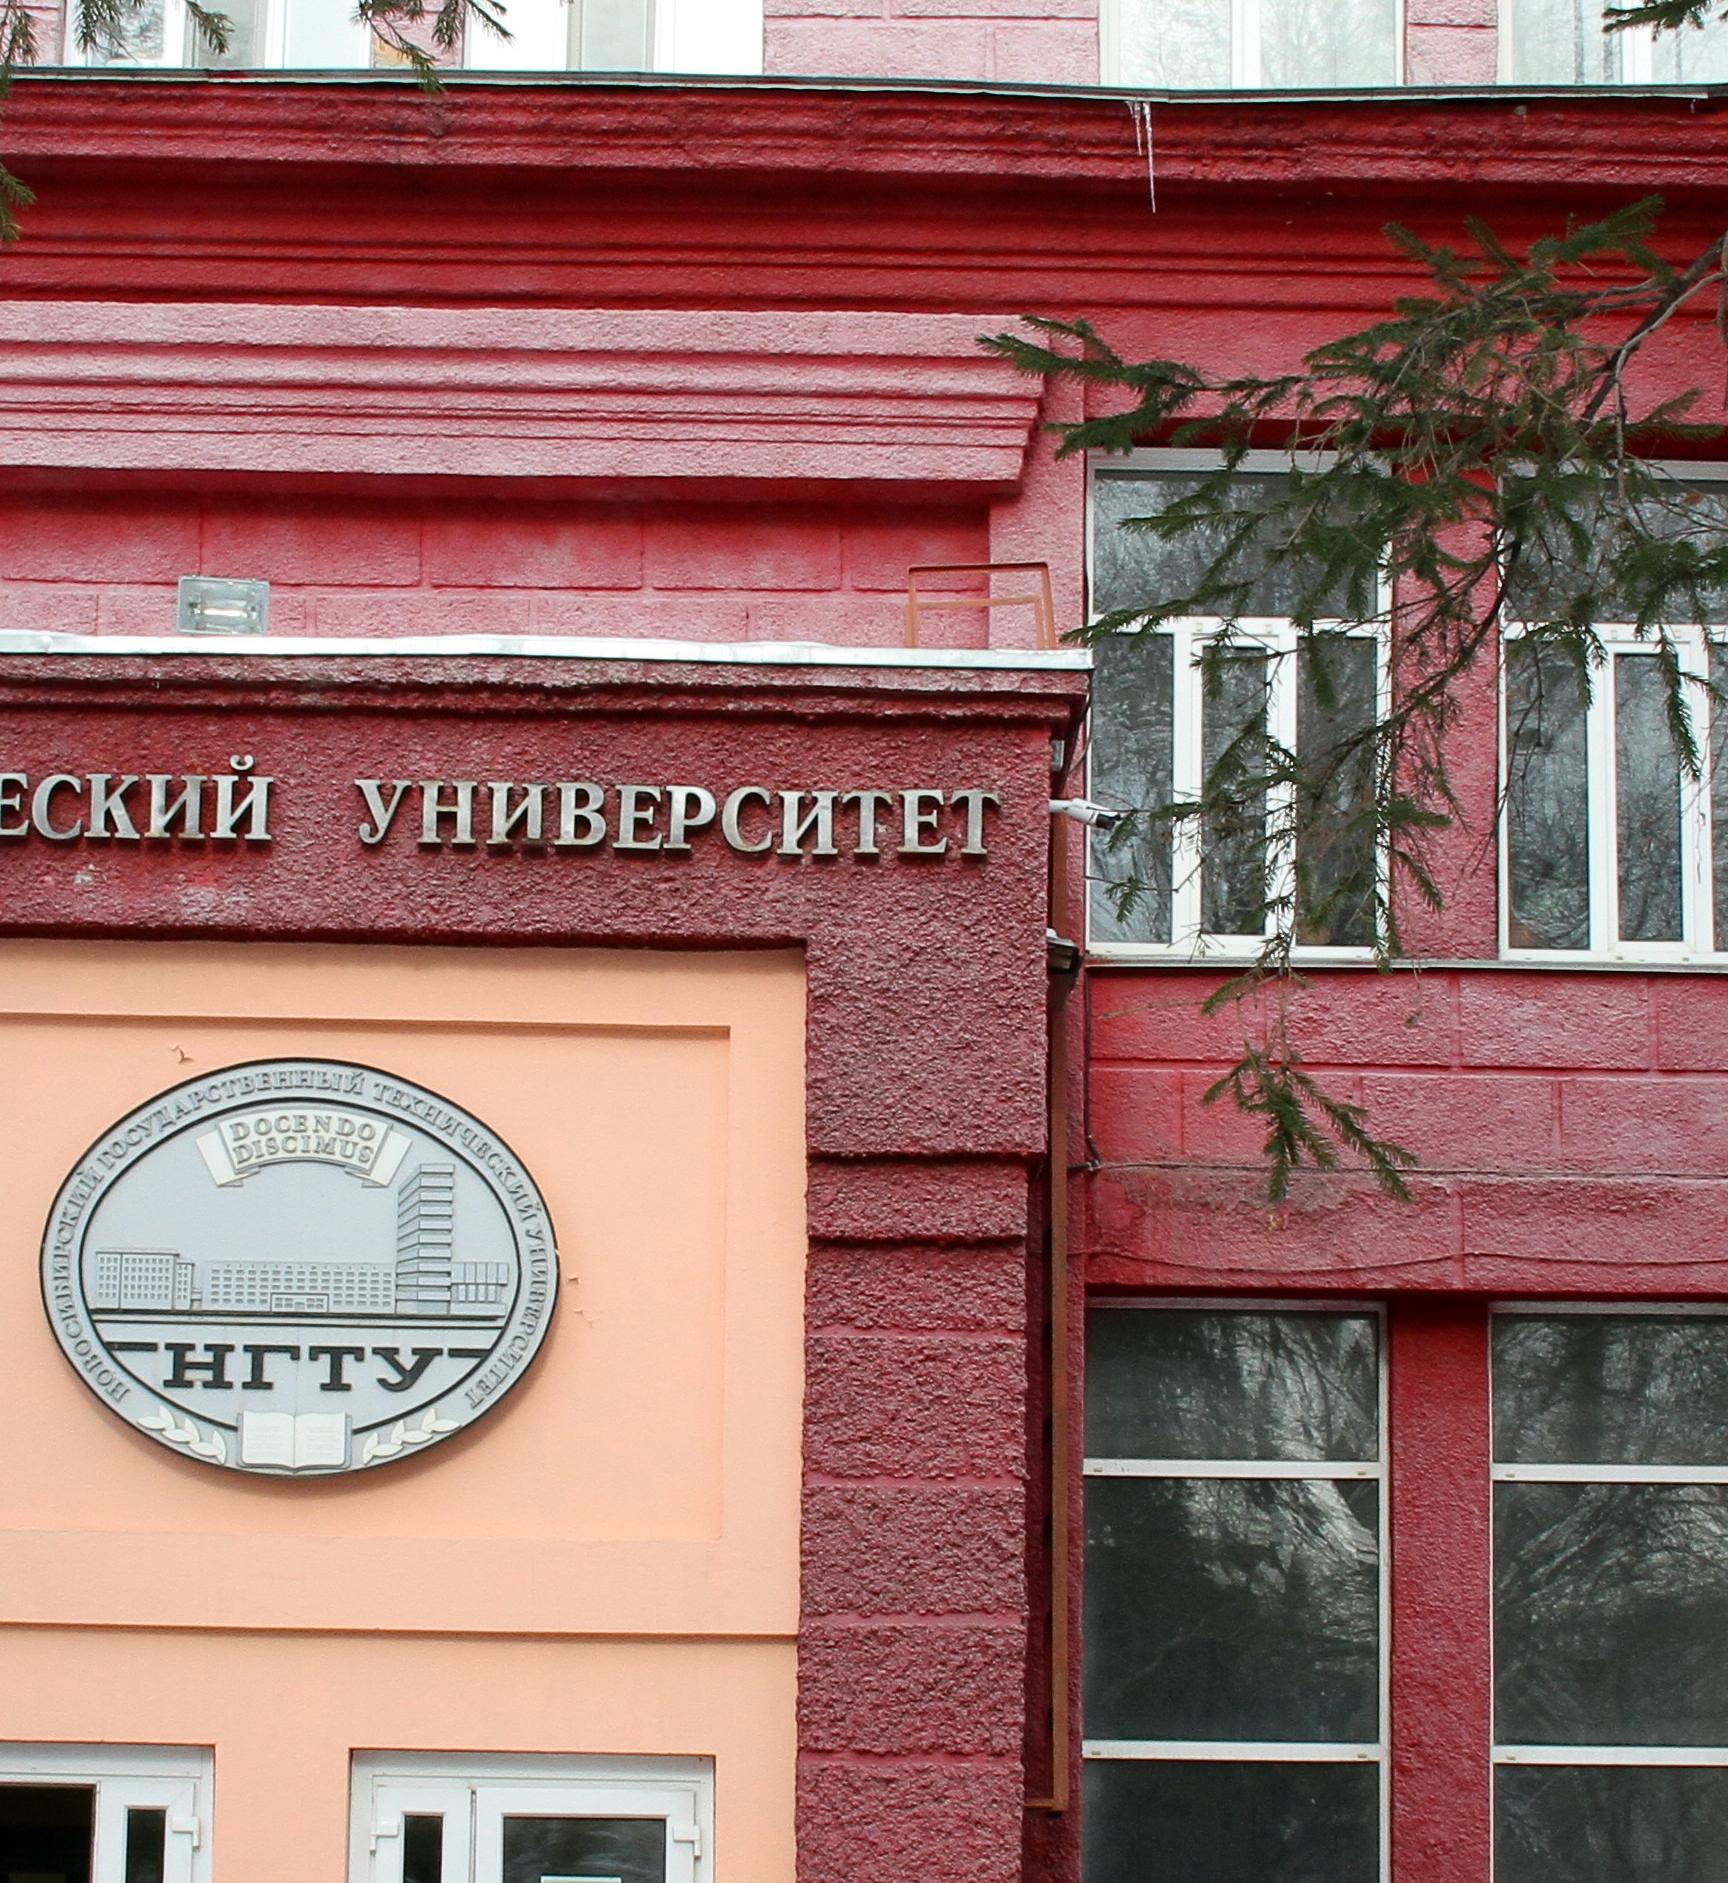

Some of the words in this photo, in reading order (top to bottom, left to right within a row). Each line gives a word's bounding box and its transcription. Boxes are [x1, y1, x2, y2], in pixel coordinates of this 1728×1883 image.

[354, 777, 1003, 859] УНИВЕРСИТЕТ
[229, 1114, 377, 1142] DOCENDO
[232, 1135, 375, 1165] DISCIMUS
[53, 1169, 131, 1404] НОВОСИБИРСКИЙ
[97, 1069, 365, 1170] ГОСУДАРСТВЕННЫЙ
[373, 1083, 541, 1223] ТЕХНИЧЕСКИЙ
[464, 1223, 549, 1410] УНИВЕРСИТЕТ
[163, 1341, 444, 1393] НГТУ
